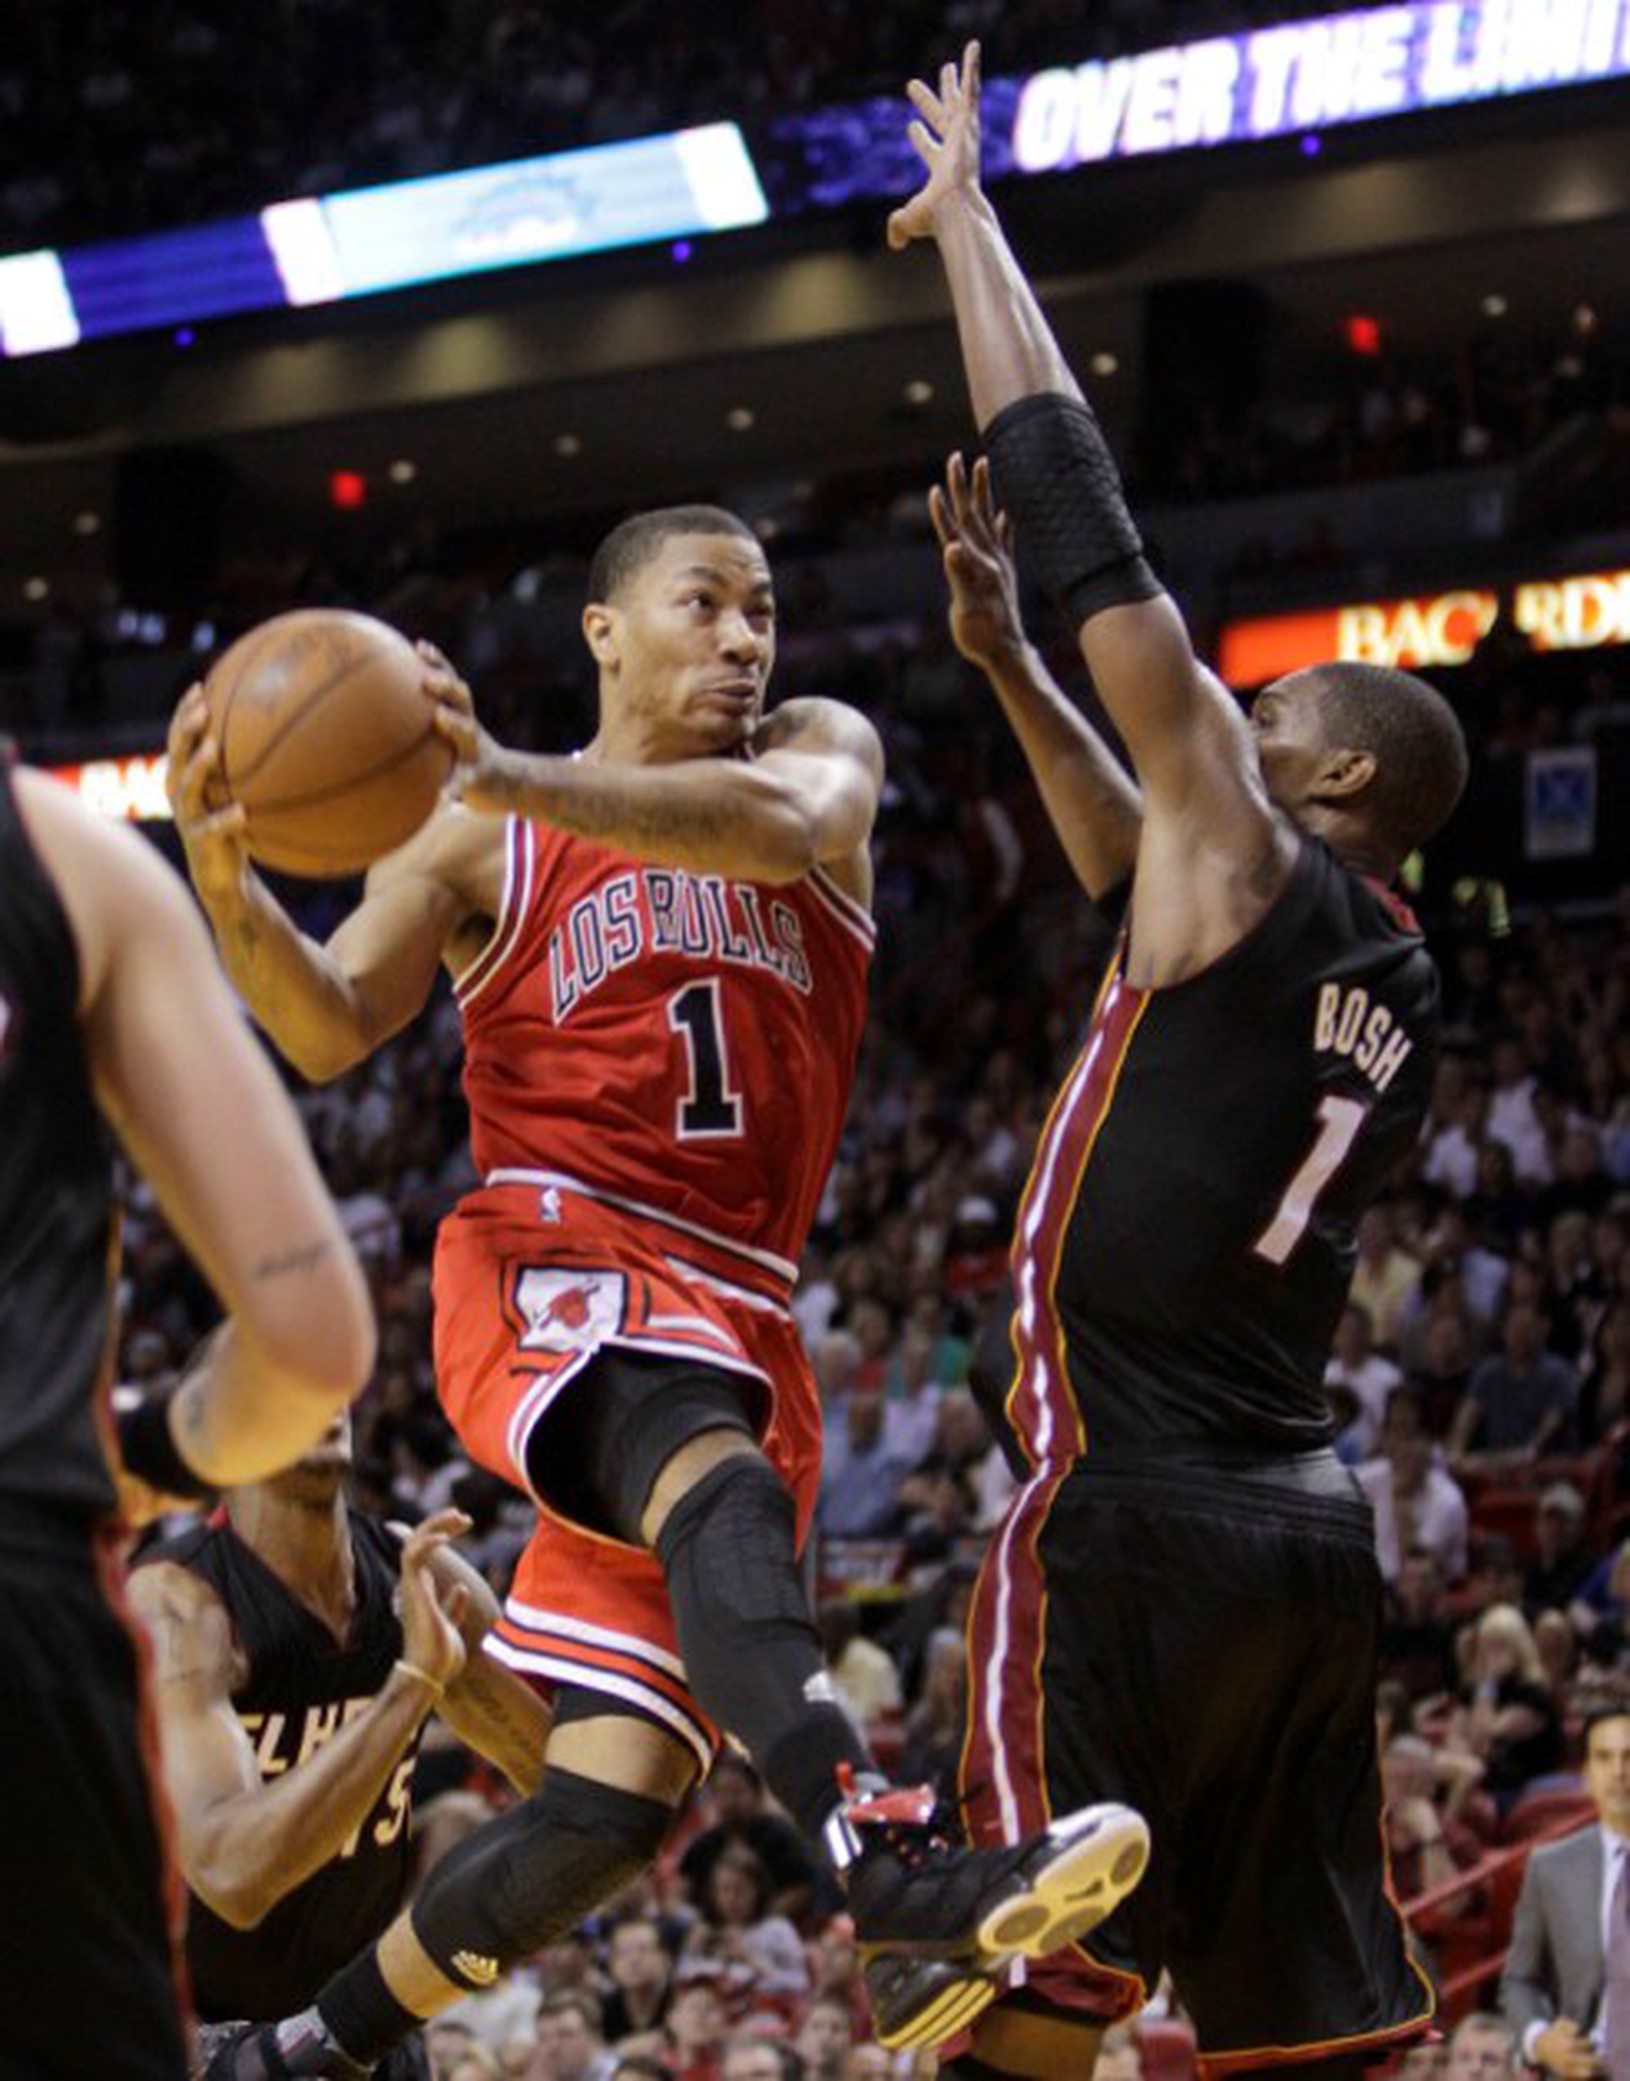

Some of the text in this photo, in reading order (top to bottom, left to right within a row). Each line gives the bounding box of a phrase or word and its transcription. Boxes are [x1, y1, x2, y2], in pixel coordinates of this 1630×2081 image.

[1013, 40, 1239, 172] OVER
[1245, 8, 1413, 140] THE
[549, 866, 813, 1028] LOS BULLS
[666, 976, 743, 1141] 1
[1314, 982, 1413, 1094] BOSH
[1254, 1094, 1367, 1266] 1
